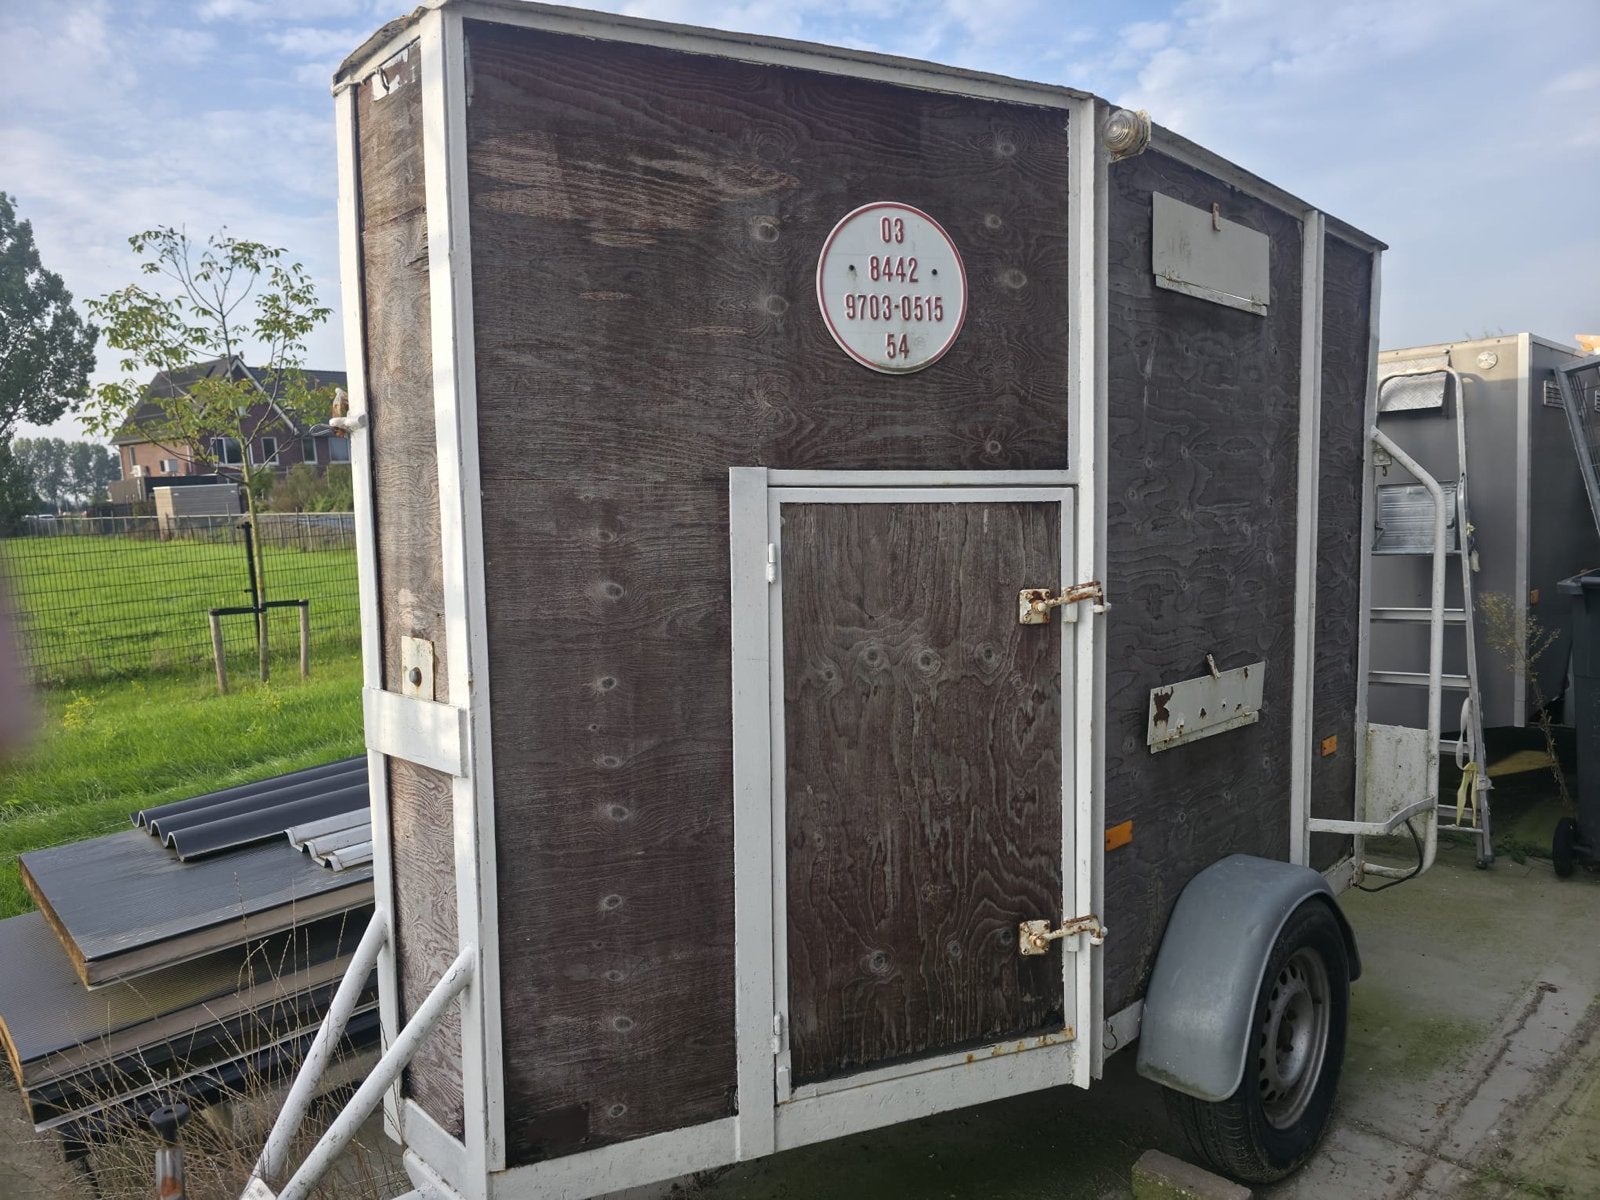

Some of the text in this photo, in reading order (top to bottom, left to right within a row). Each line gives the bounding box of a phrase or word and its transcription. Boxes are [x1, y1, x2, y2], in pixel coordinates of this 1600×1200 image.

[880, 216, 904, 244] 03
[868, 255, 919, 283] 8442
[844, 294, 944, 322] 9703-0515
[885, 332, 910, 360] 54
